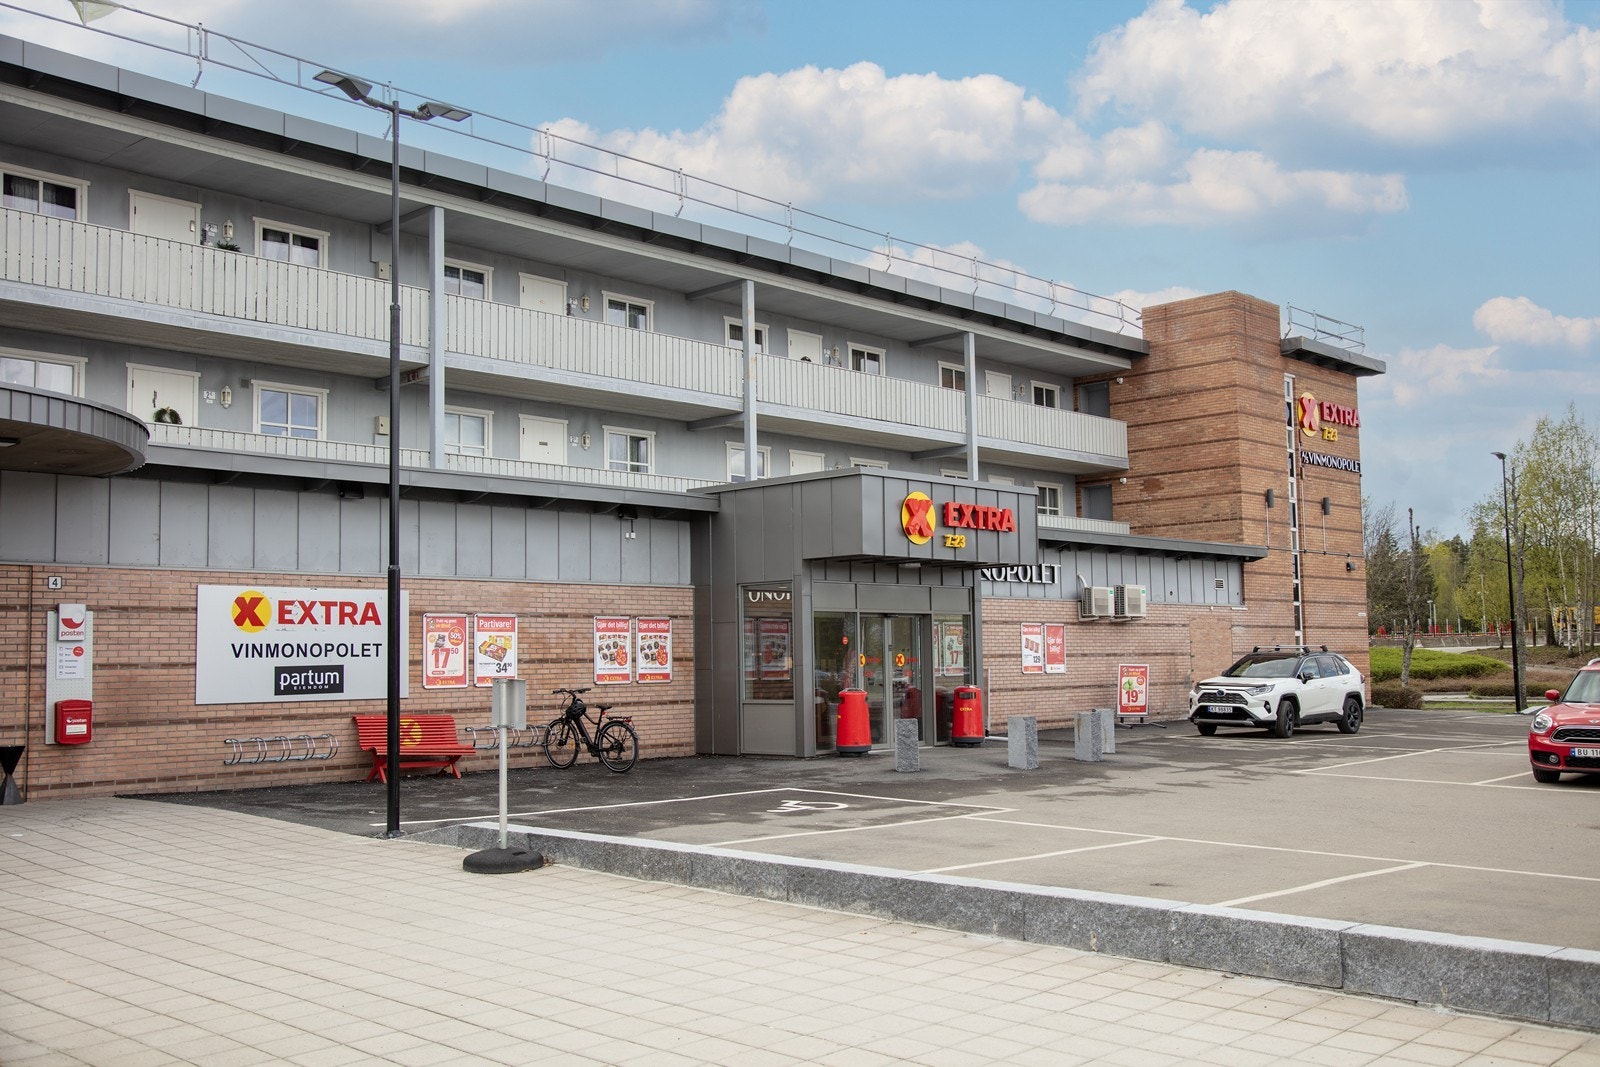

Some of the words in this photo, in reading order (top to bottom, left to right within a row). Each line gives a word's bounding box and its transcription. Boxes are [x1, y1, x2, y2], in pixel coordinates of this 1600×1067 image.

[1320, 401, 1360, 428] EXTRA
[1308, 452, 1360, 472] VINMONOPOLE
[943, 502, 1016, 532] EXTRA
[52, 578, 58, 587] 4
[278, 600, 382, 625] EXTRA
[479, 619, 511, 628] Partivare!
[231, 643, 382, 658] VINMONOPOLET
[432, 647, 450, 668] 17
[496, 662, 507, 673] 34
[280, 670, 339, 690] partum
[1125, 689, 1138, 703] 19
